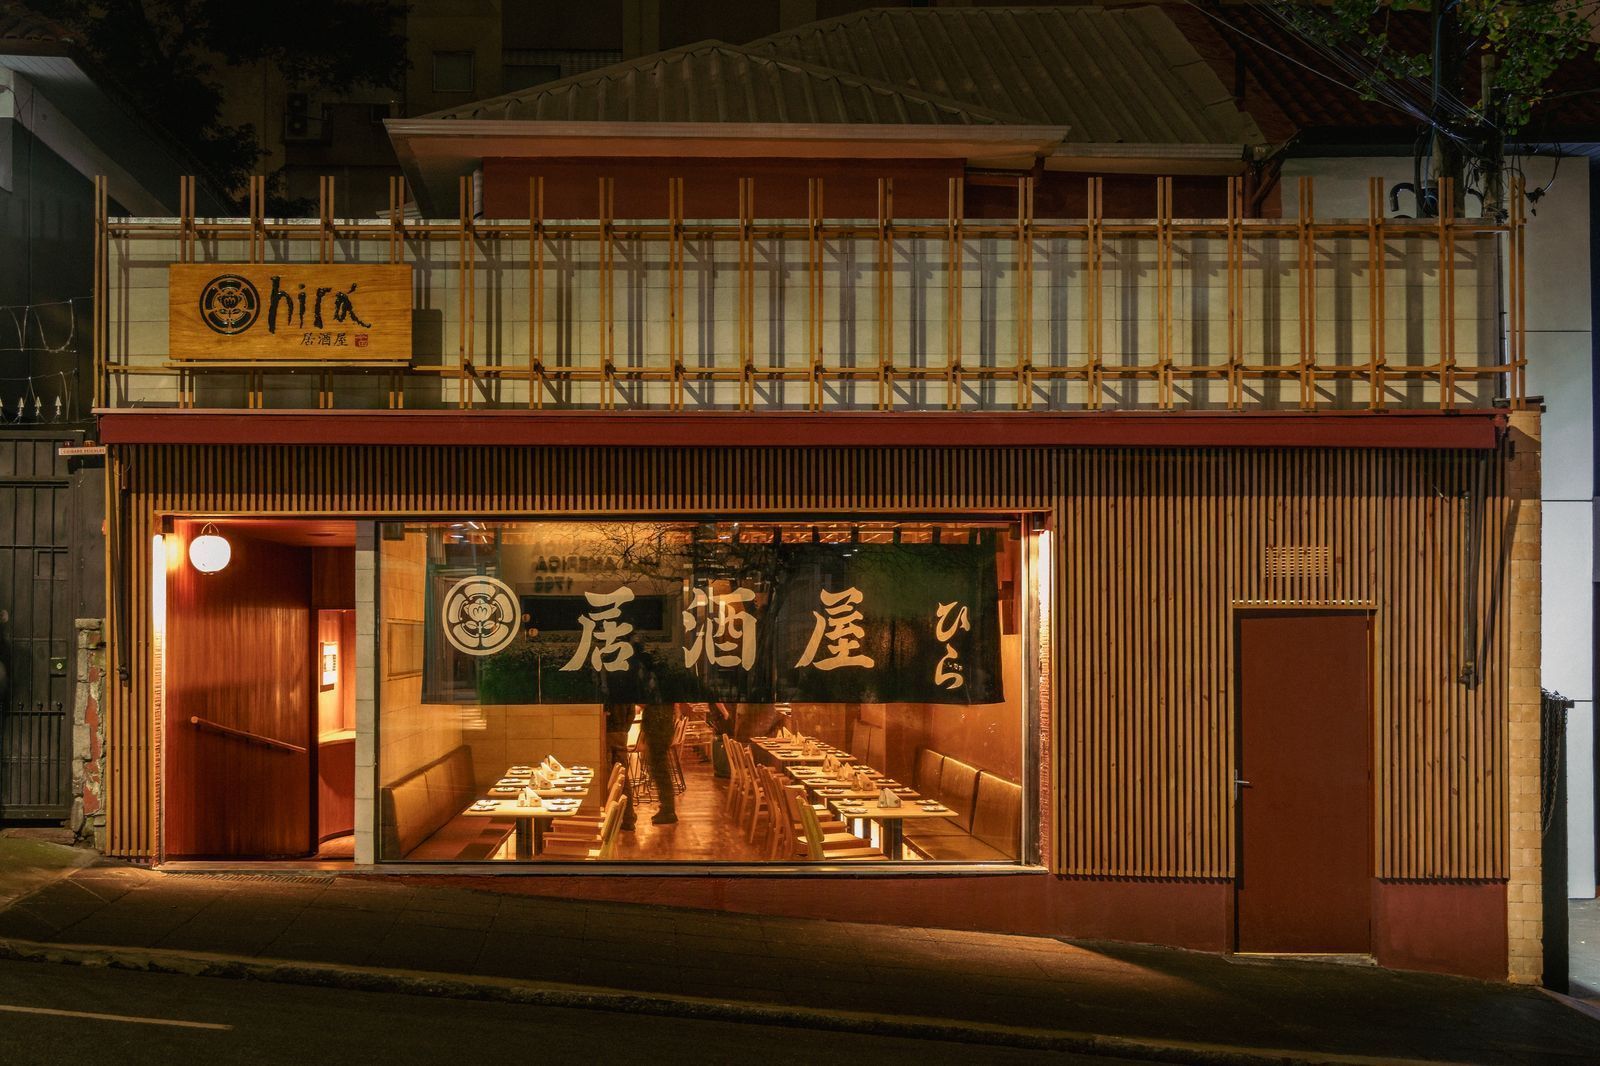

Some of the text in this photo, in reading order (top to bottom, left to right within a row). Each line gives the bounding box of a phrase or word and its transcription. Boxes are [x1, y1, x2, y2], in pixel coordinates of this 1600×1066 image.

[300, 332, 348, 347] 居酒屋
[559, 586, 875, 672] 居酒屋
[934, 601, 971, 689] ひら
